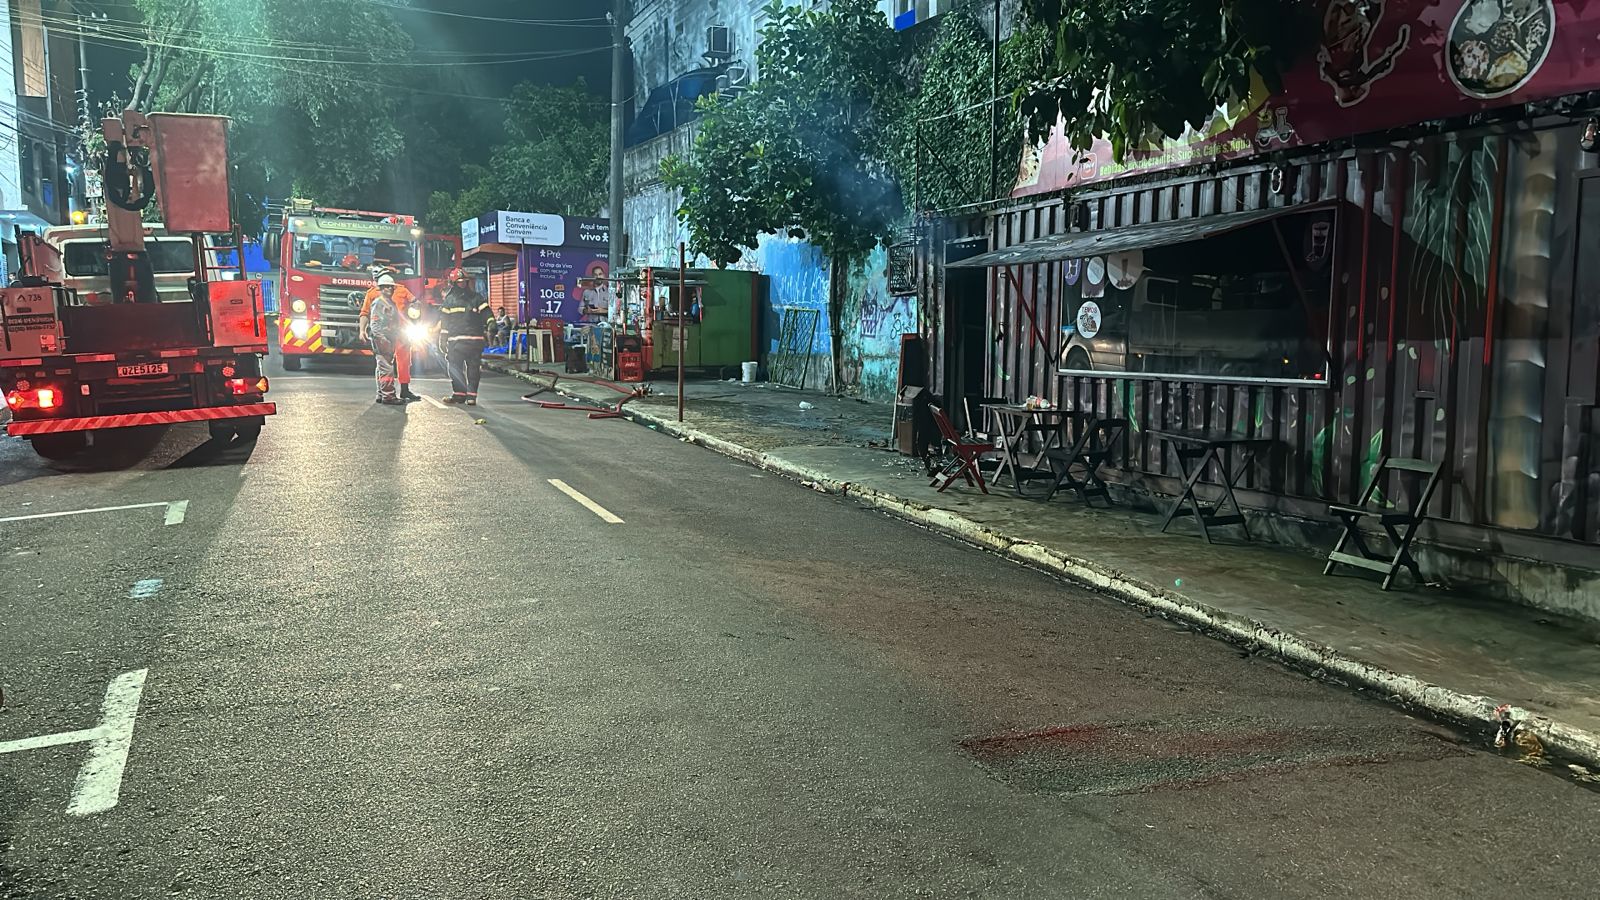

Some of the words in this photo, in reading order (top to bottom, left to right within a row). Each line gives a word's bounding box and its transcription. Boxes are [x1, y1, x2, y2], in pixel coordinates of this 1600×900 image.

[321, 221, 394, 231] CONSTELLATION
[505, 222, 548, 230] Conveniência
[580, 222, 596, 231] Aqui
[580, 231, 601, 242] vivo
[547, 249, 561, 258] Pré
[545, 300, 562, 314] 17
